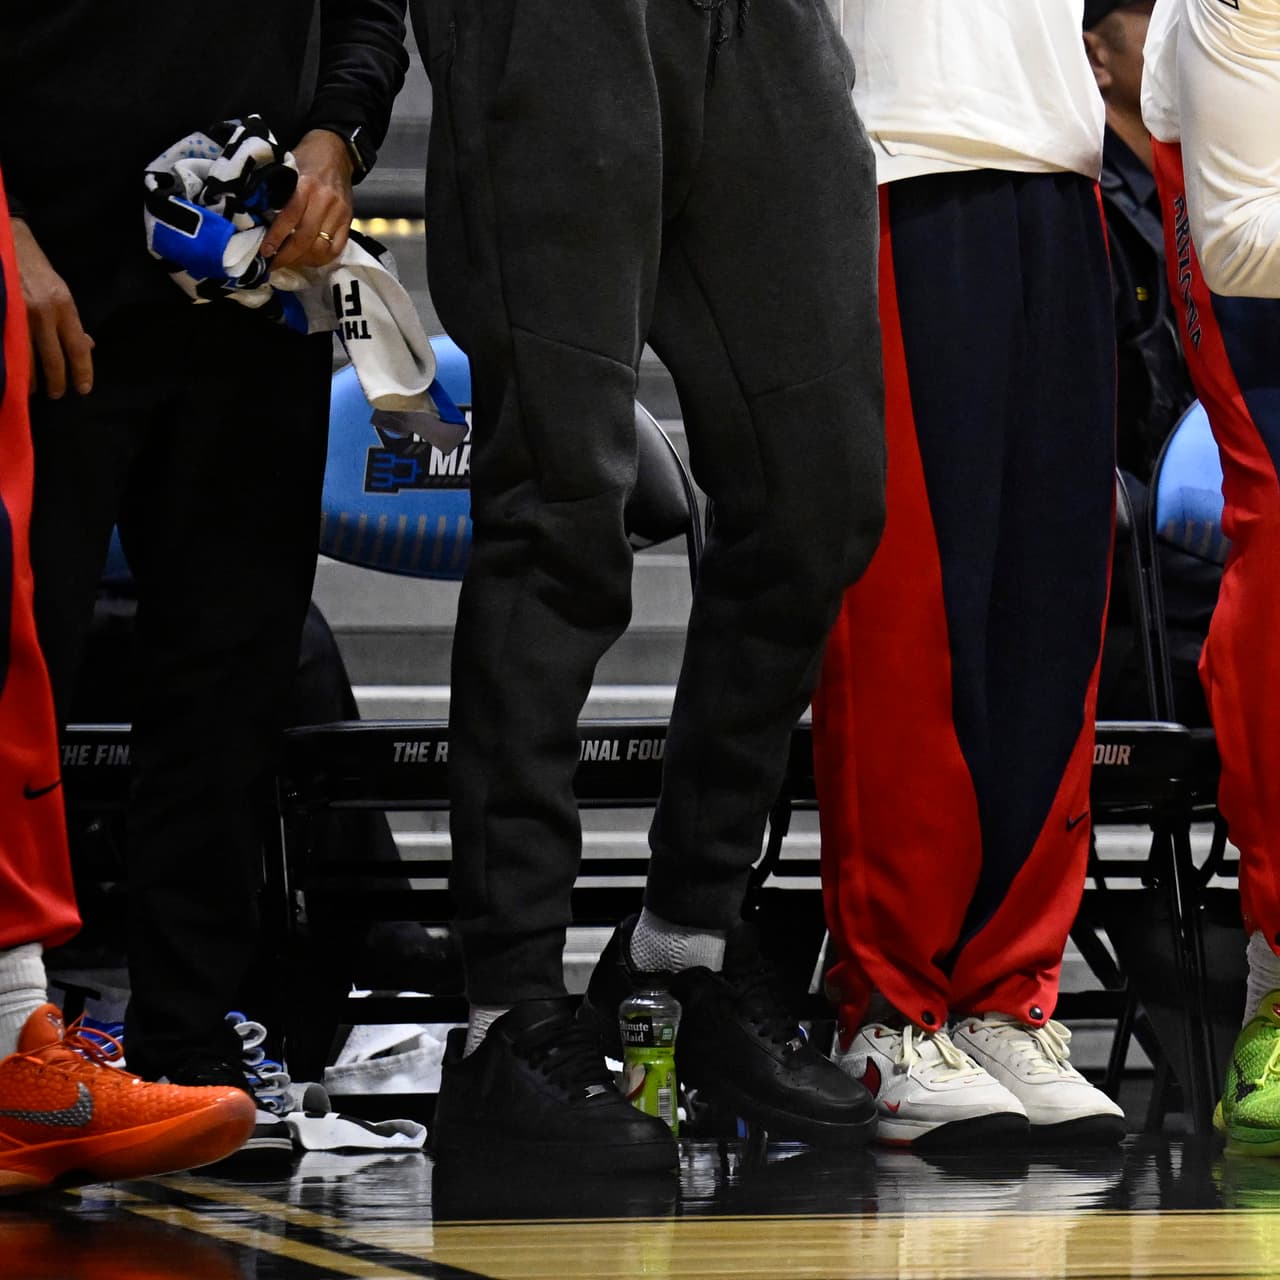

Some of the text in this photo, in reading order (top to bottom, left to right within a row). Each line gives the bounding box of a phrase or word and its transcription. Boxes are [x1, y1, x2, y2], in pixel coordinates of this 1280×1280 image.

[393, 741, 431, 763] THE
[626, 739, 666, 761] FOU
[1092, 744, 1131, 766] OUR
